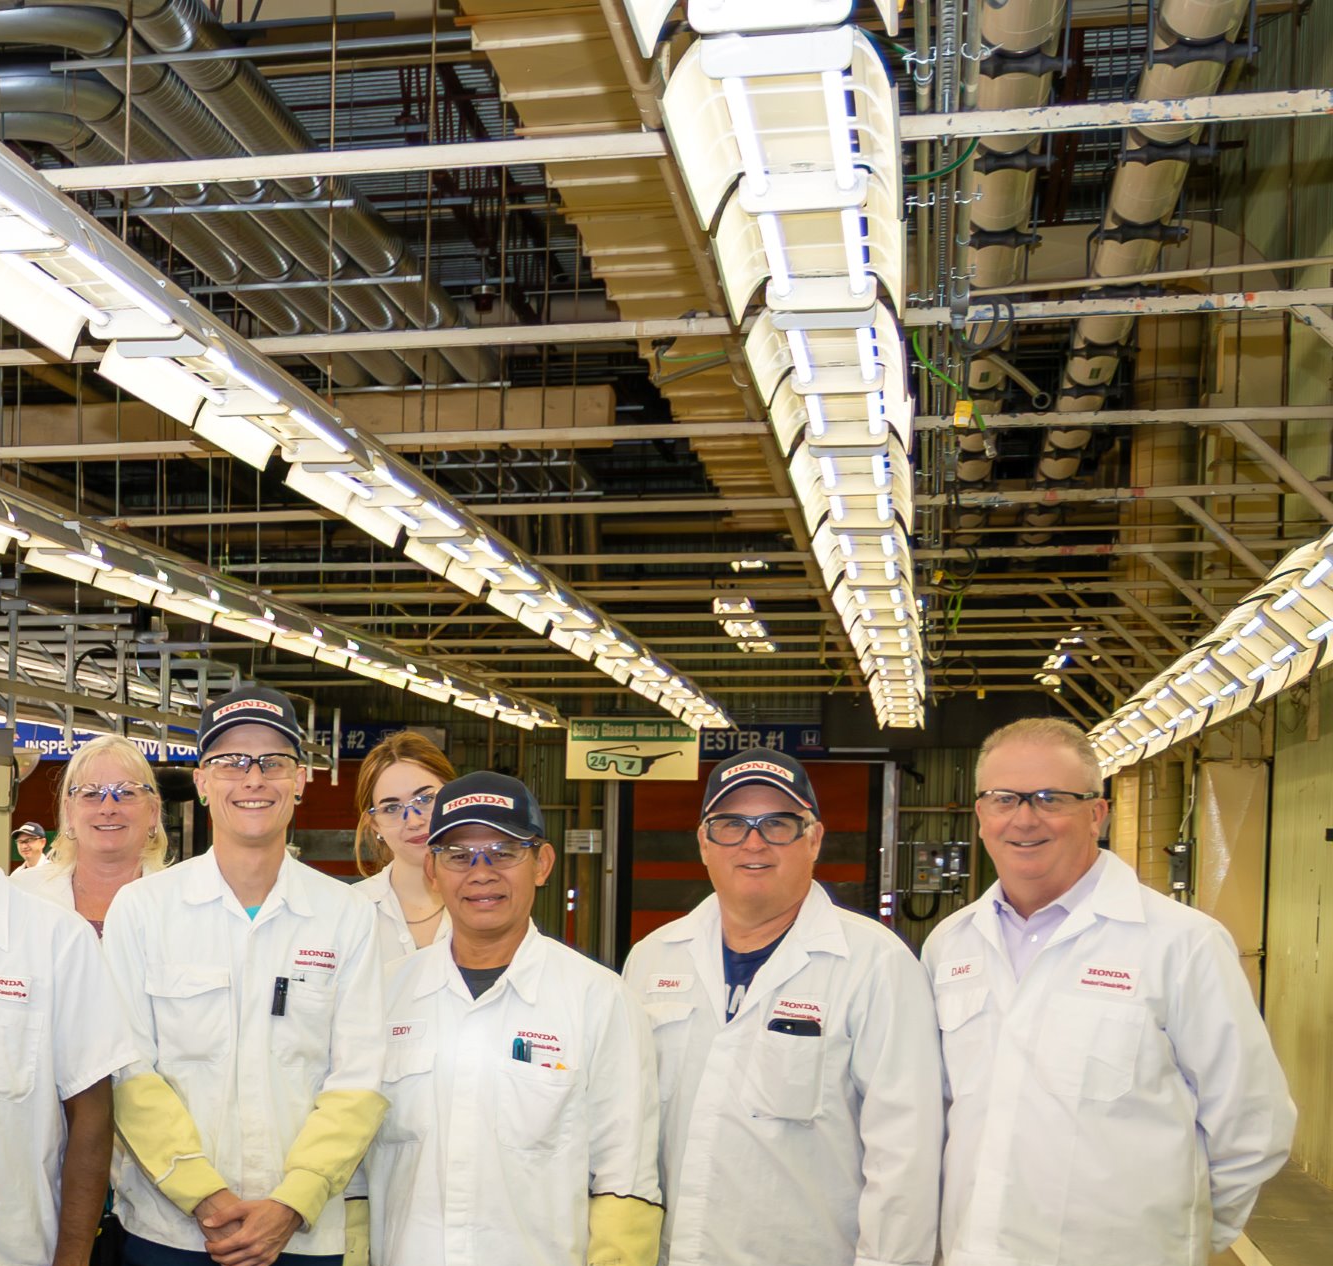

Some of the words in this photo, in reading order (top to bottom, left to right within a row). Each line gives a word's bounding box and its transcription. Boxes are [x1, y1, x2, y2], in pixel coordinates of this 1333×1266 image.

[218, 700, 279, 715] HONDA
[347, 730, 366, 749] #2
[700, 731, 761, 750] ESTER
[765, 731, 784, 750] #1
[25, 740, 88, 755] INSPECT
[590, 756, 607, 767] 24
[624, 760, 636, 770] 7
[727, 762, 789, 778] HONDA
[447, 795, 510, 810] HONDA
[299, 949, 336, 959] HONDA
[951, 964, 971, 976] DAVE
[1087, 968, 1131, 980] HONDA
[657, 979, 681, 988] BRIAN
[779, 1000, 821, 1012] HONDA
[392, 1026, 412, 1036] EDDY
[517, 1031, 559, 1042] HONDA
